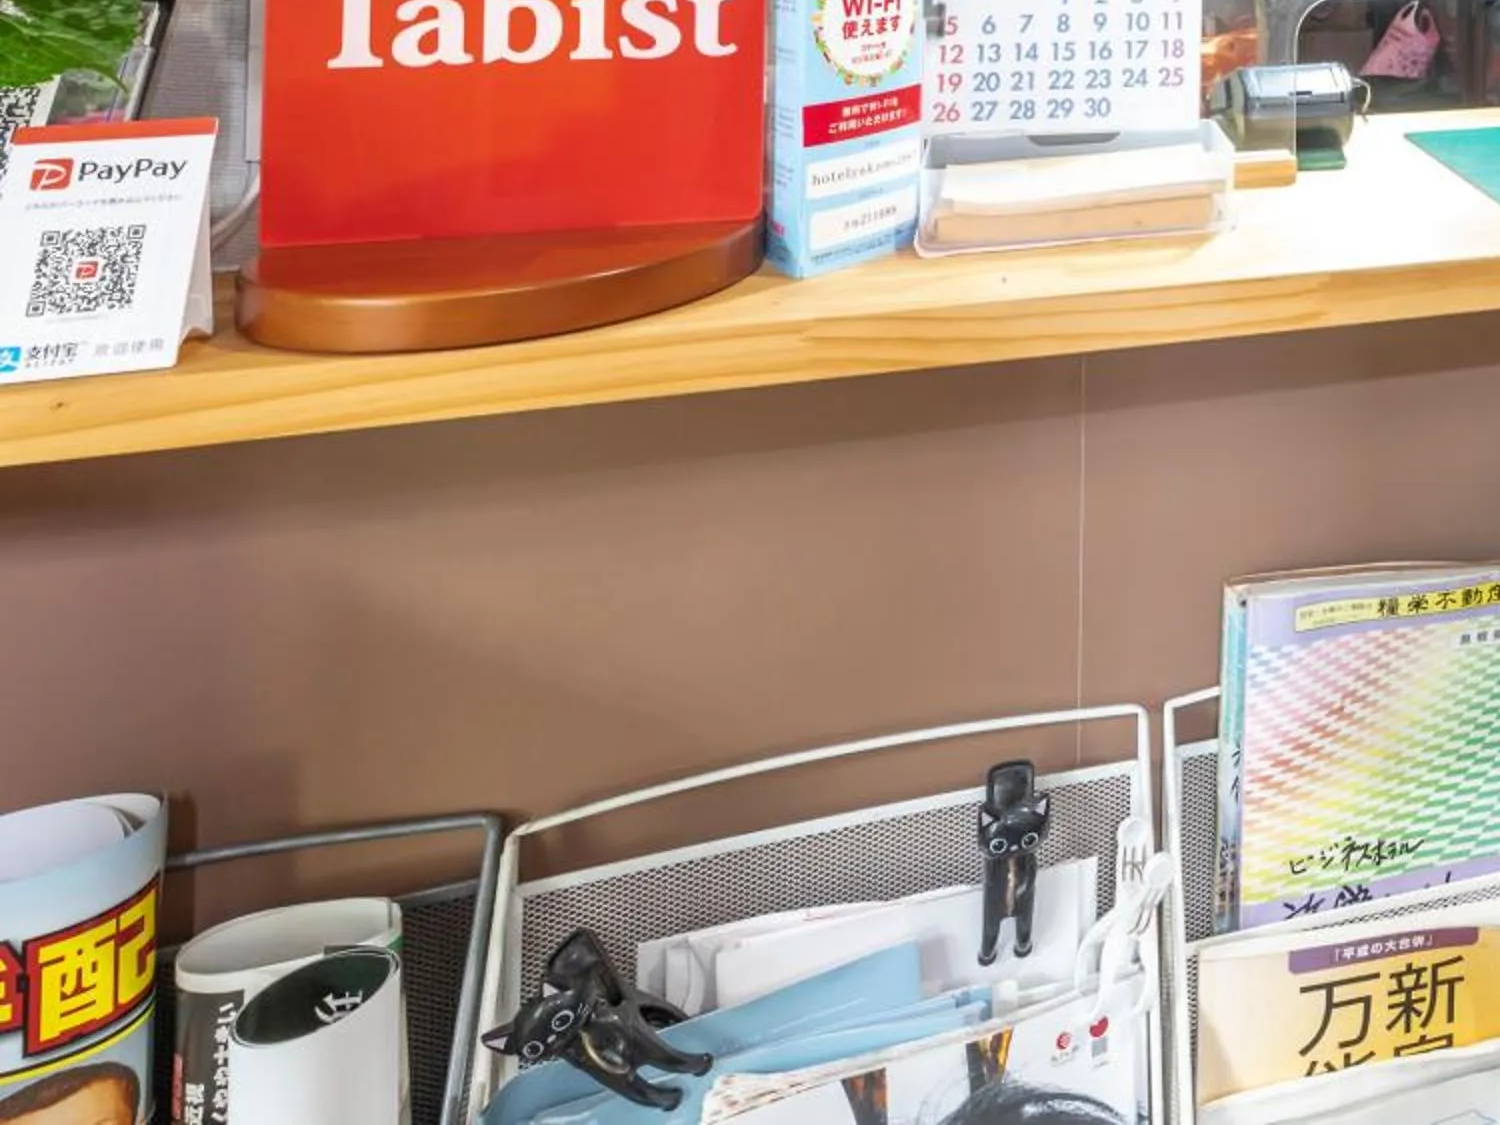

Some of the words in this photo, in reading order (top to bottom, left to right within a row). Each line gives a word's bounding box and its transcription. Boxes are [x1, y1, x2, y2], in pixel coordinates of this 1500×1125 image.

[842, 16, 902, 41] 使えます
[945, 16, 958, 35] 5
[982, 15, 996, 34] 6
[1020, 15, 1033, 33] 7
[1057, 14, 1069, 33] 8
[1093, 13, 1107, 31] 9
[1125, 12, 1150, 30] 10
[1162, 11, 1183, 29] 11
[938, 45, 963, 64] 12
[976, 44, 1001, 63] 13
[1014, 43, 1038, 62] 14
[1051, 42, 1076, 61] 15
[1088, 41, 1112, 60] 16
[1124, 40, 1147, 59] 17
[1161, 39, 1184, 58] 18
[936, 74, 962, 93] 19
[973, 73, 1000, 91] 20
[1011, 72, 1034, 91] 21
[1049, 70, 1074, 90] 22
[1085, 69, 1111, 89] 23
[1122, 69, 1147, 87] 24
[1158, 67, 1183, 87] 25
[933, 103, 960, 122] 26
[971, 101, 998, 121] 27
[1010, 100, 1035, 120] 28
[1047, 98, 1074, 118] 29
[1084, 98, 1110, 117] 30
[78, 158, 189, 183] PayPay
[0, 887, 156, 1043] 配
